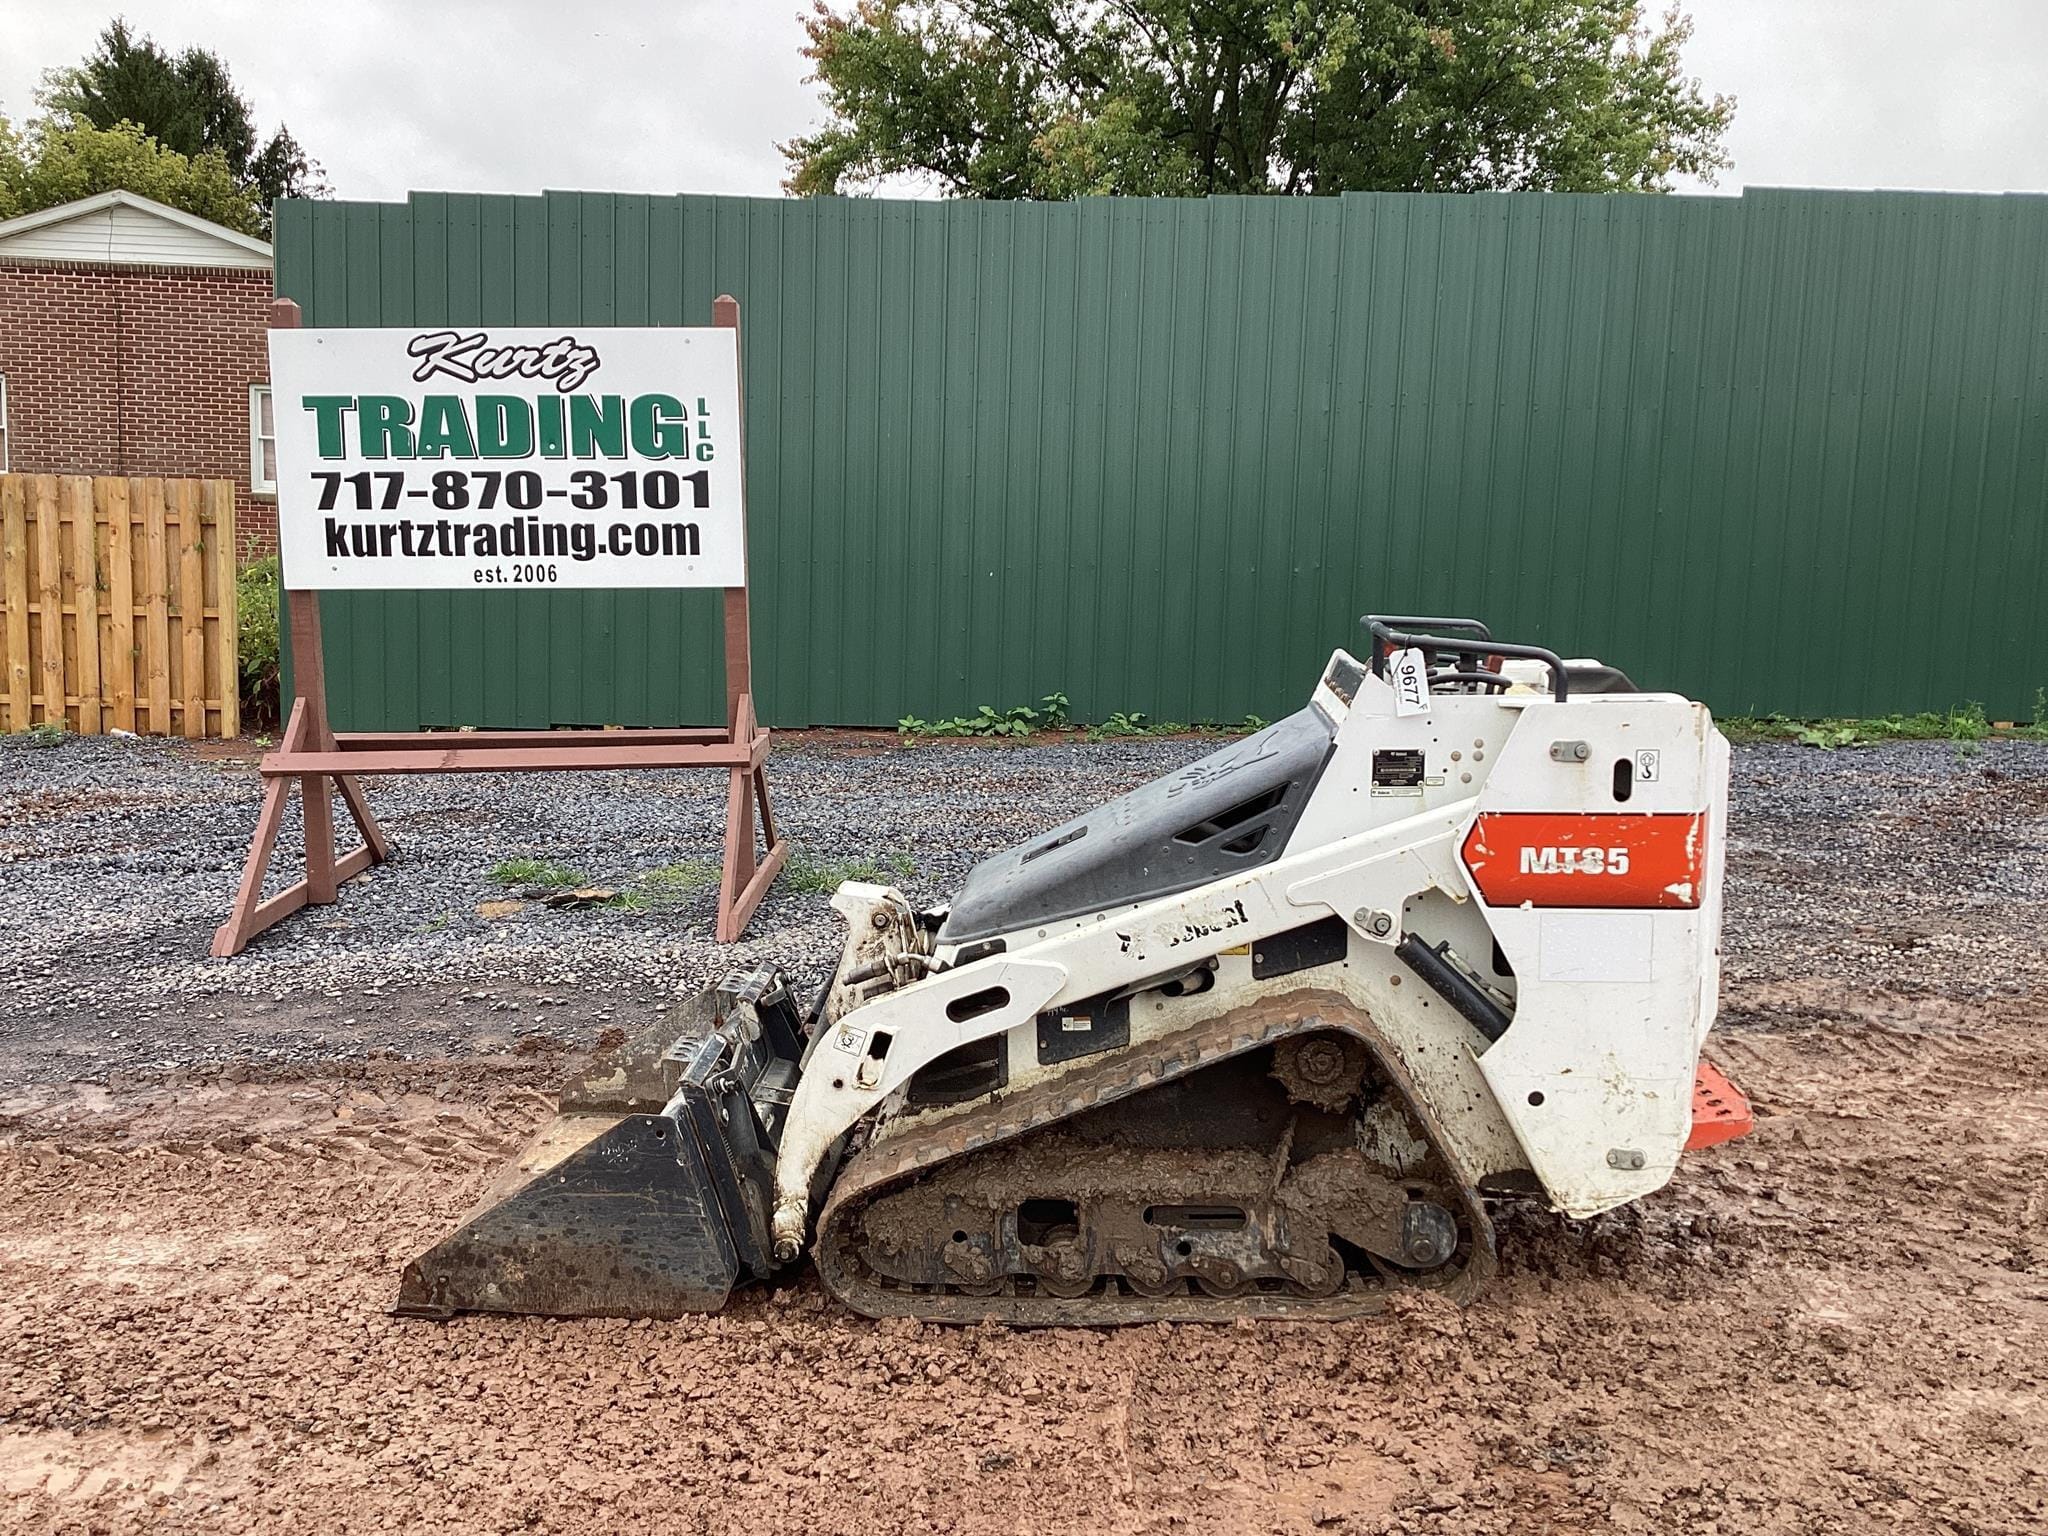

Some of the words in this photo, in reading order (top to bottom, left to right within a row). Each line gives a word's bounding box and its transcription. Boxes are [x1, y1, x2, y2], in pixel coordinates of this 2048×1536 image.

[407, 331, 600, 393] Kurtz
[301, 393, 690, 461] TRADING
[696, 397, 714, 462] LLC
[311, 470, 711, 511] 717-870-3101
[324, 516, 701, 561] kurtztrading.com
[473, 566, 508, 584] est.
[513, 564, 558, 583] 2006
[1401, 665, 1420, 705] 9677
[1519, 846, 1630, 876] MT85
